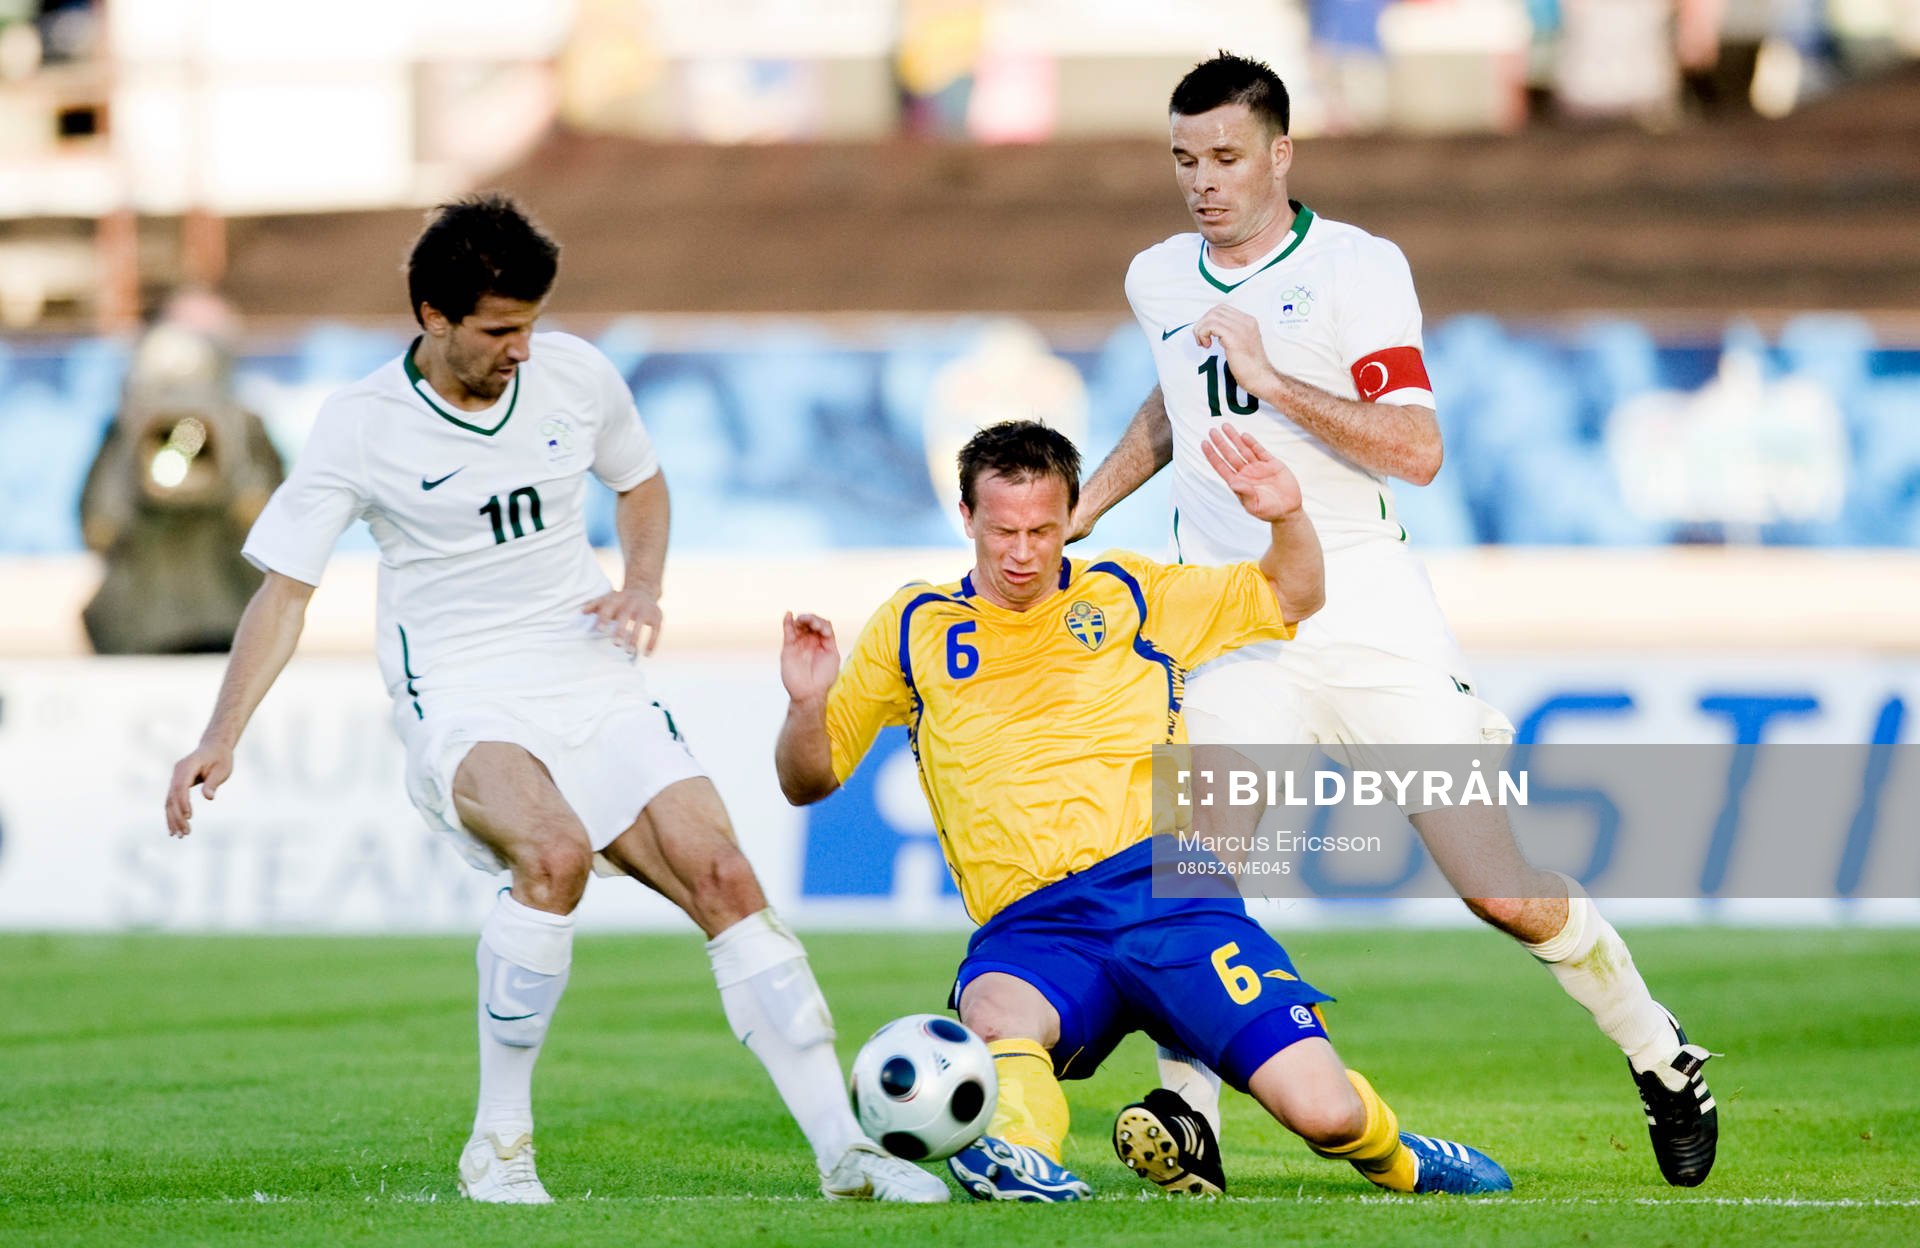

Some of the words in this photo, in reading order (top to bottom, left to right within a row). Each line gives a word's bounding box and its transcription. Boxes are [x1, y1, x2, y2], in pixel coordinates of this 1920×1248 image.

[1198, 354, 1259, 417] 10
[479, 486, 545, 545] 10
[946, 620, 980, 680] 6
[1210, 941, 1263, 1006] 6
